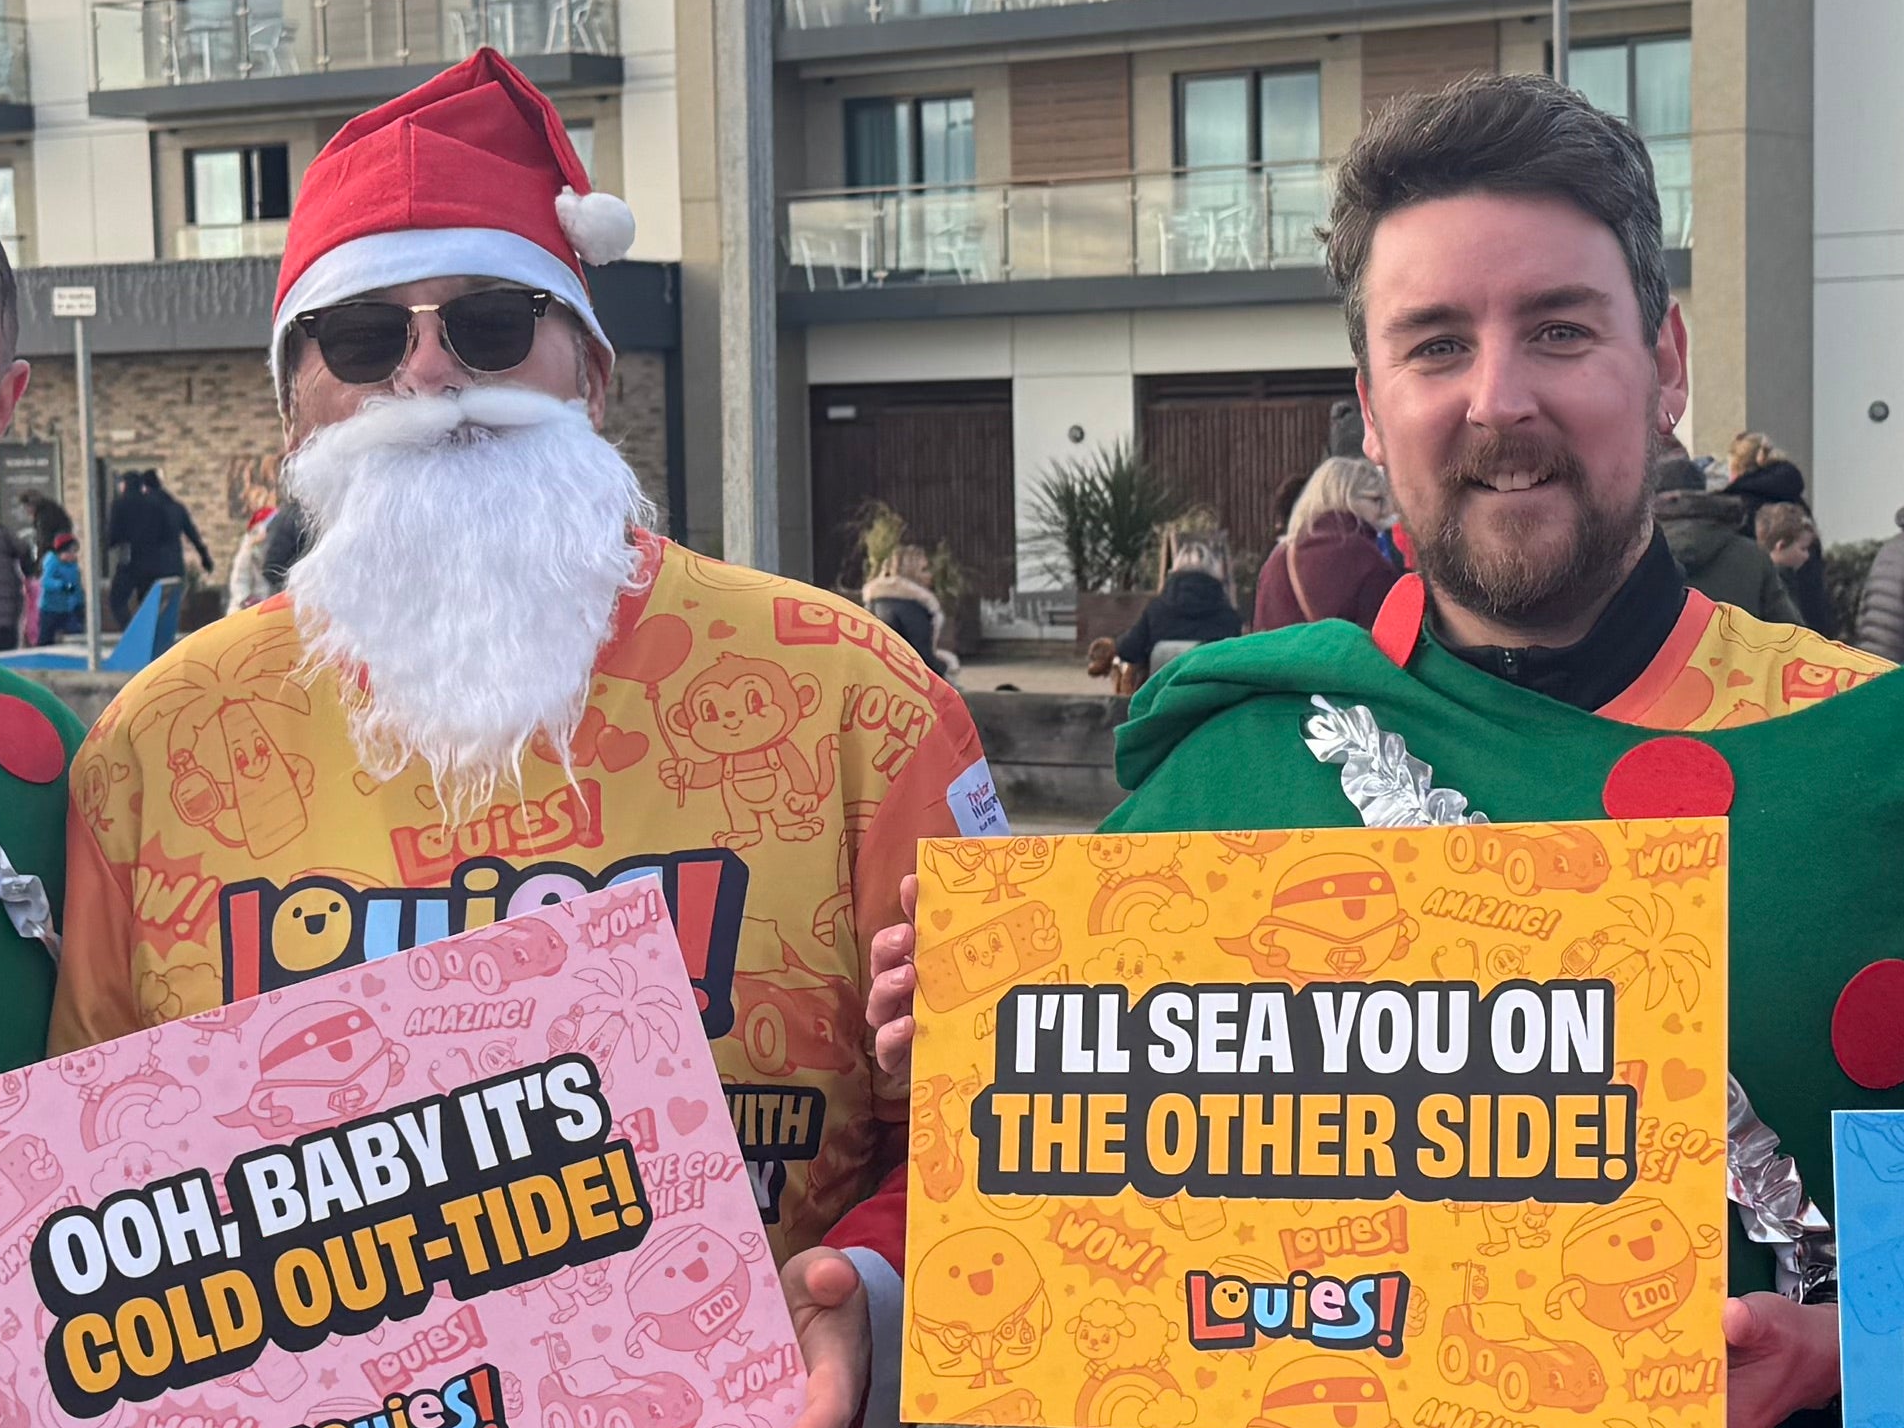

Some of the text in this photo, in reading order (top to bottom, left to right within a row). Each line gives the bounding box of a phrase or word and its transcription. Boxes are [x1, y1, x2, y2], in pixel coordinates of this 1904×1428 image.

[1636, 832, 1721, 878] WOW!
[586, 888, 660, 949] WOW!
[1421, 886, 1562, 942] AMAZING!
[403, 997, 537, 1037] AMAZING!
[1015, 993, 1130, 1073] I'LL
[1147, 991, 1295, 1074] SEA
[1311, 990, 1470, 1074] YOU
[1490, 988, 1605, 1074] ON
[684, 1150, 744, 1183] GOT
[991, 1092, 1628, 1181] THE OTHER SIDE!
[1661, 1121, 1726, 1166] GOT
[48, 1177, 241, 1295] OOH,
[242, 1103, 451, 1238] BABY
[459, 1060, 604, 1170] IT'S
[1056, 1212, 1167, 1284] WOW!
[1278, 1204, 1409, 1270] Louies!
[62, 1147, 646, 1393] COLD OUT-TIDE!
[1631, 1282, 1673, 1311] 100
[698, 1292, 736, 1326] 100
[1190, 1274, 1401, 1348] Louies!
[360, 1303, 488, 1396] Louies!
[722, 1343, 797, 1403] WOW!
[1632, 1358, 1720, 1400] WOW!
